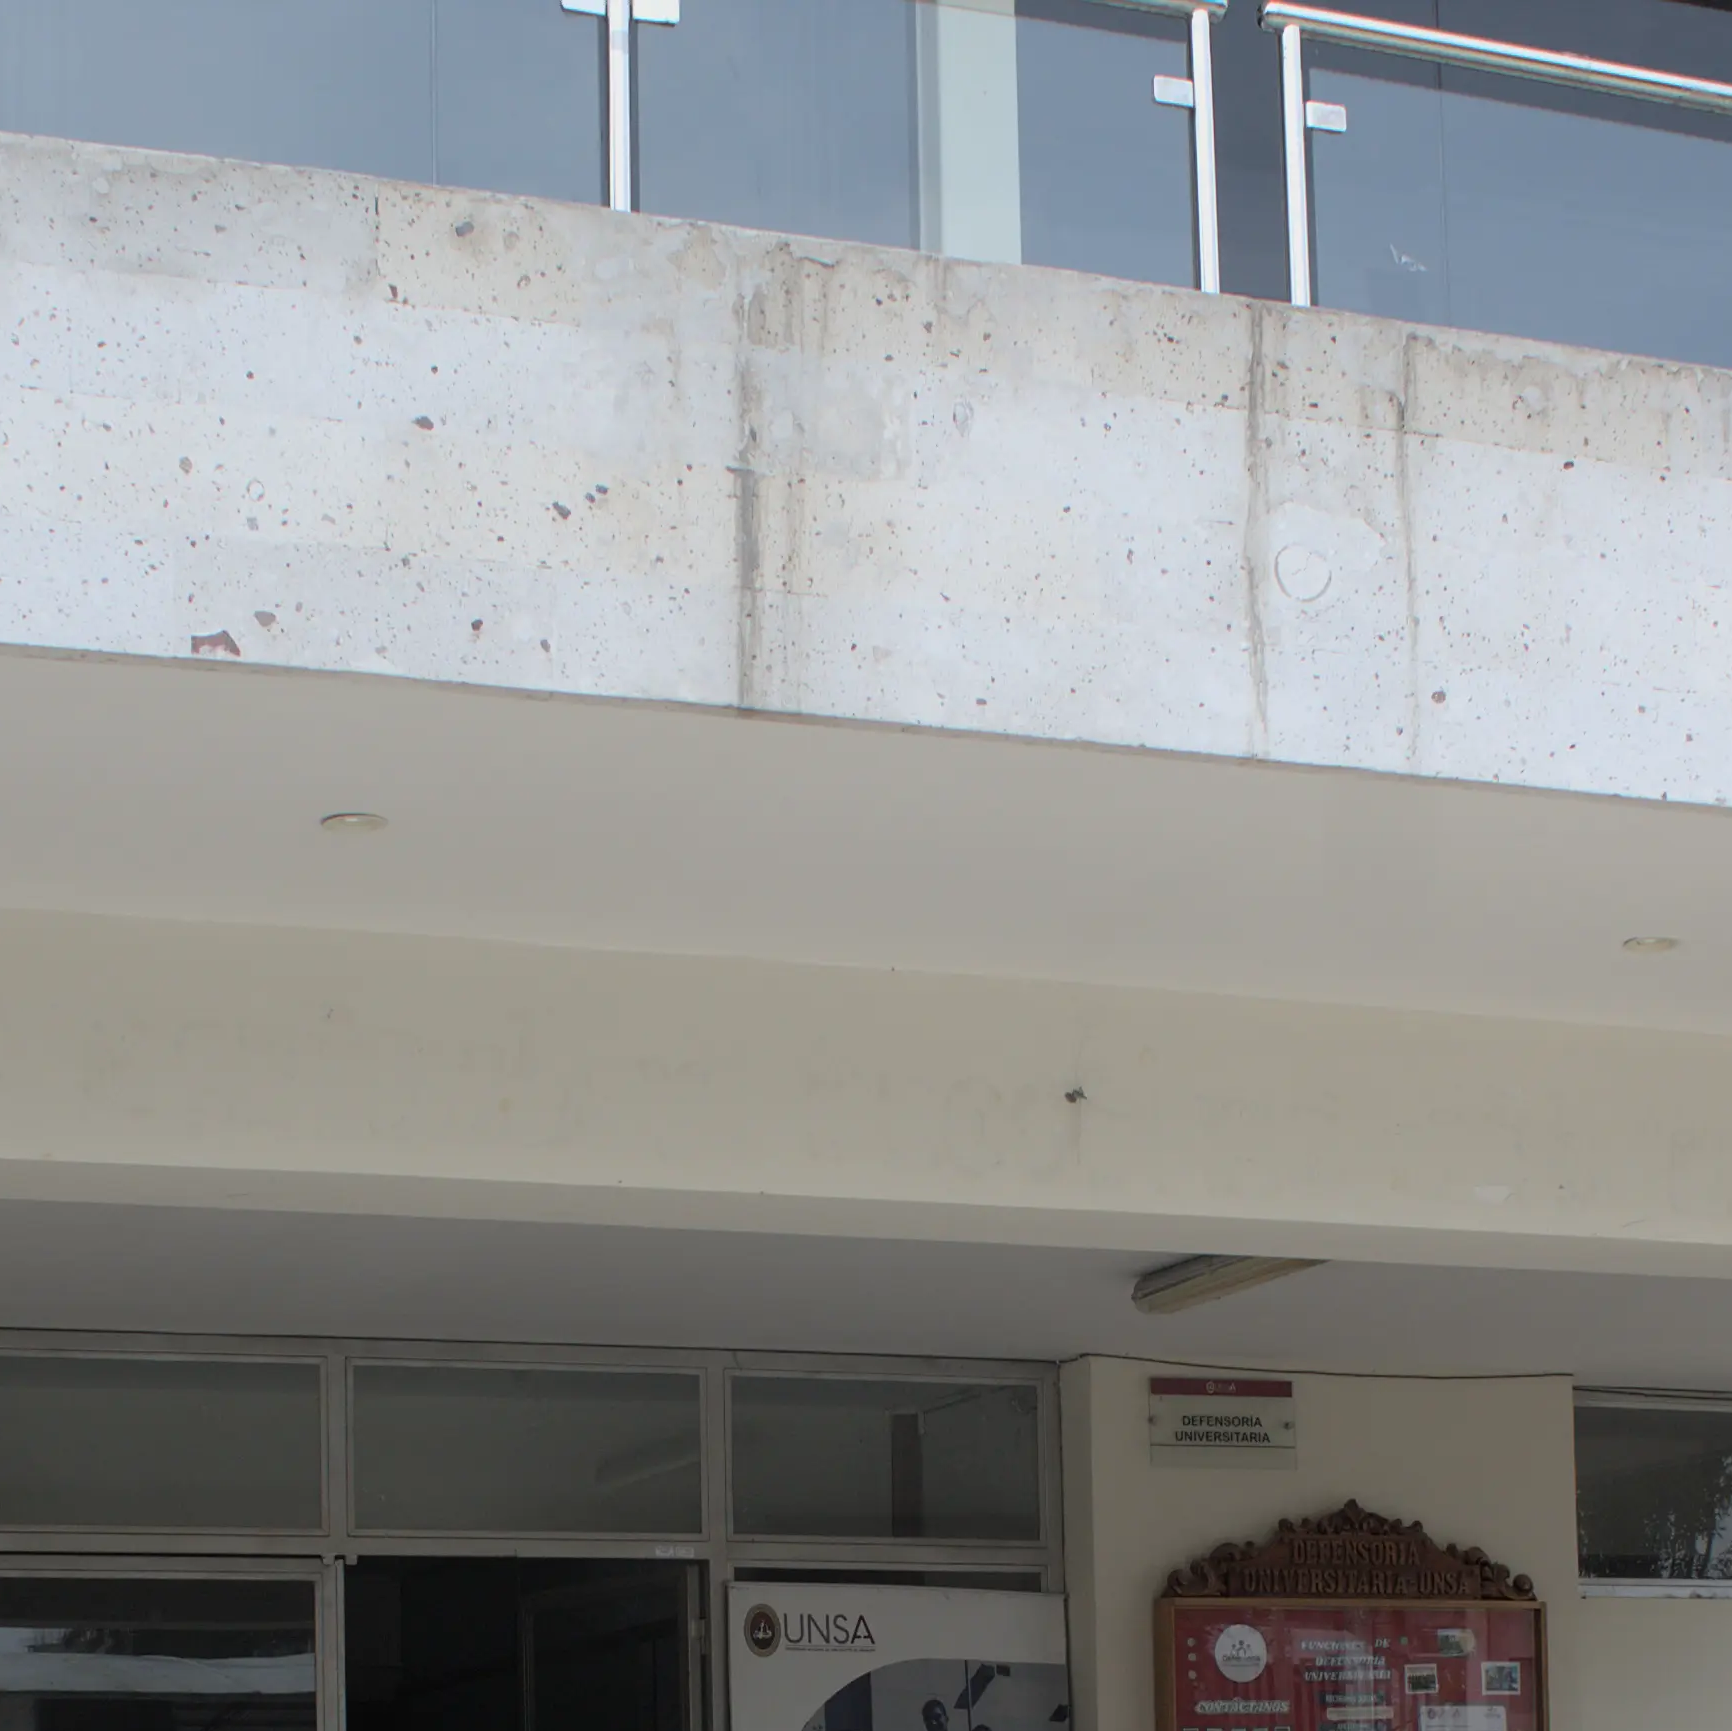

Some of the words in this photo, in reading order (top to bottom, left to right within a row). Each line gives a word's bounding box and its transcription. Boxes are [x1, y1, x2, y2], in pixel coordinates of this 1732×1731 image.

[1182, 1414, 1262, 1427] DEFENSORÍA
[1175, 1431, 1270, 1443] UNIVERSITARIA
[783, 1614, 876, 1645] UNSA
